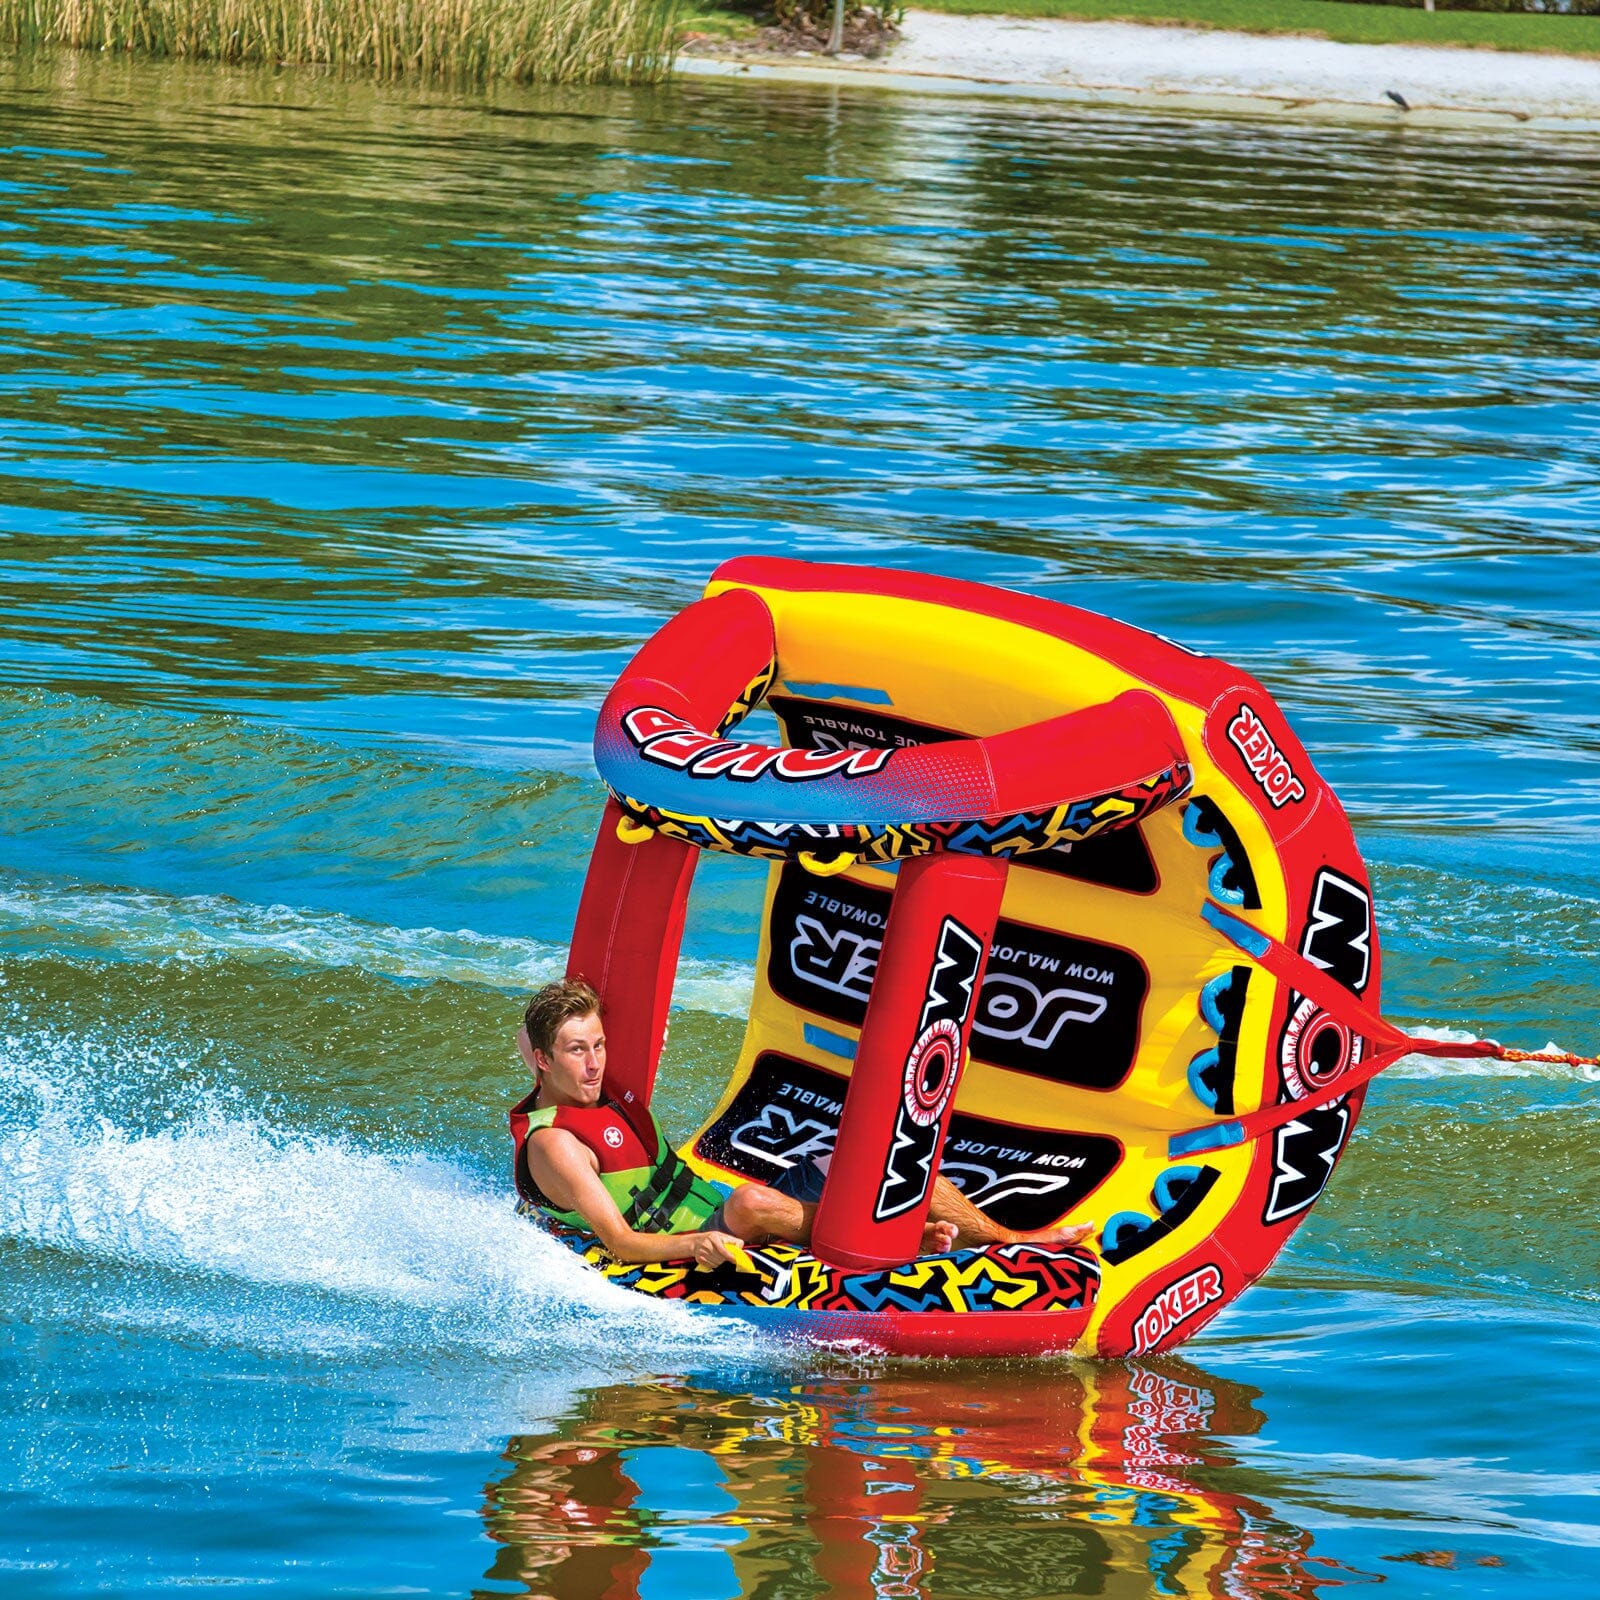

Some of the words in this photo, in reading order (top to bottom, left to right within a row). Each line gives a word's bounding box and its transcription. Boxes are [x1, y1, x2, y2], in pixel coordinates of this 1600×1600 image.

[803, 715, 887, 742] TOWABLE
[1229, 704, 1305, 808] JOKER
[989, 943, 1061, 973] MAJOR
[1066, 963, 1115, 986] WOW
[873, 916, 984, 1212] WOW
[776, 1082, 843, 1115] WABLE
[953, 1139, 1031, 1162] MAJOR
[1033, 1153, 1087, 1169] WOW
[1132, 1264, 1223, 1357] JOKER
